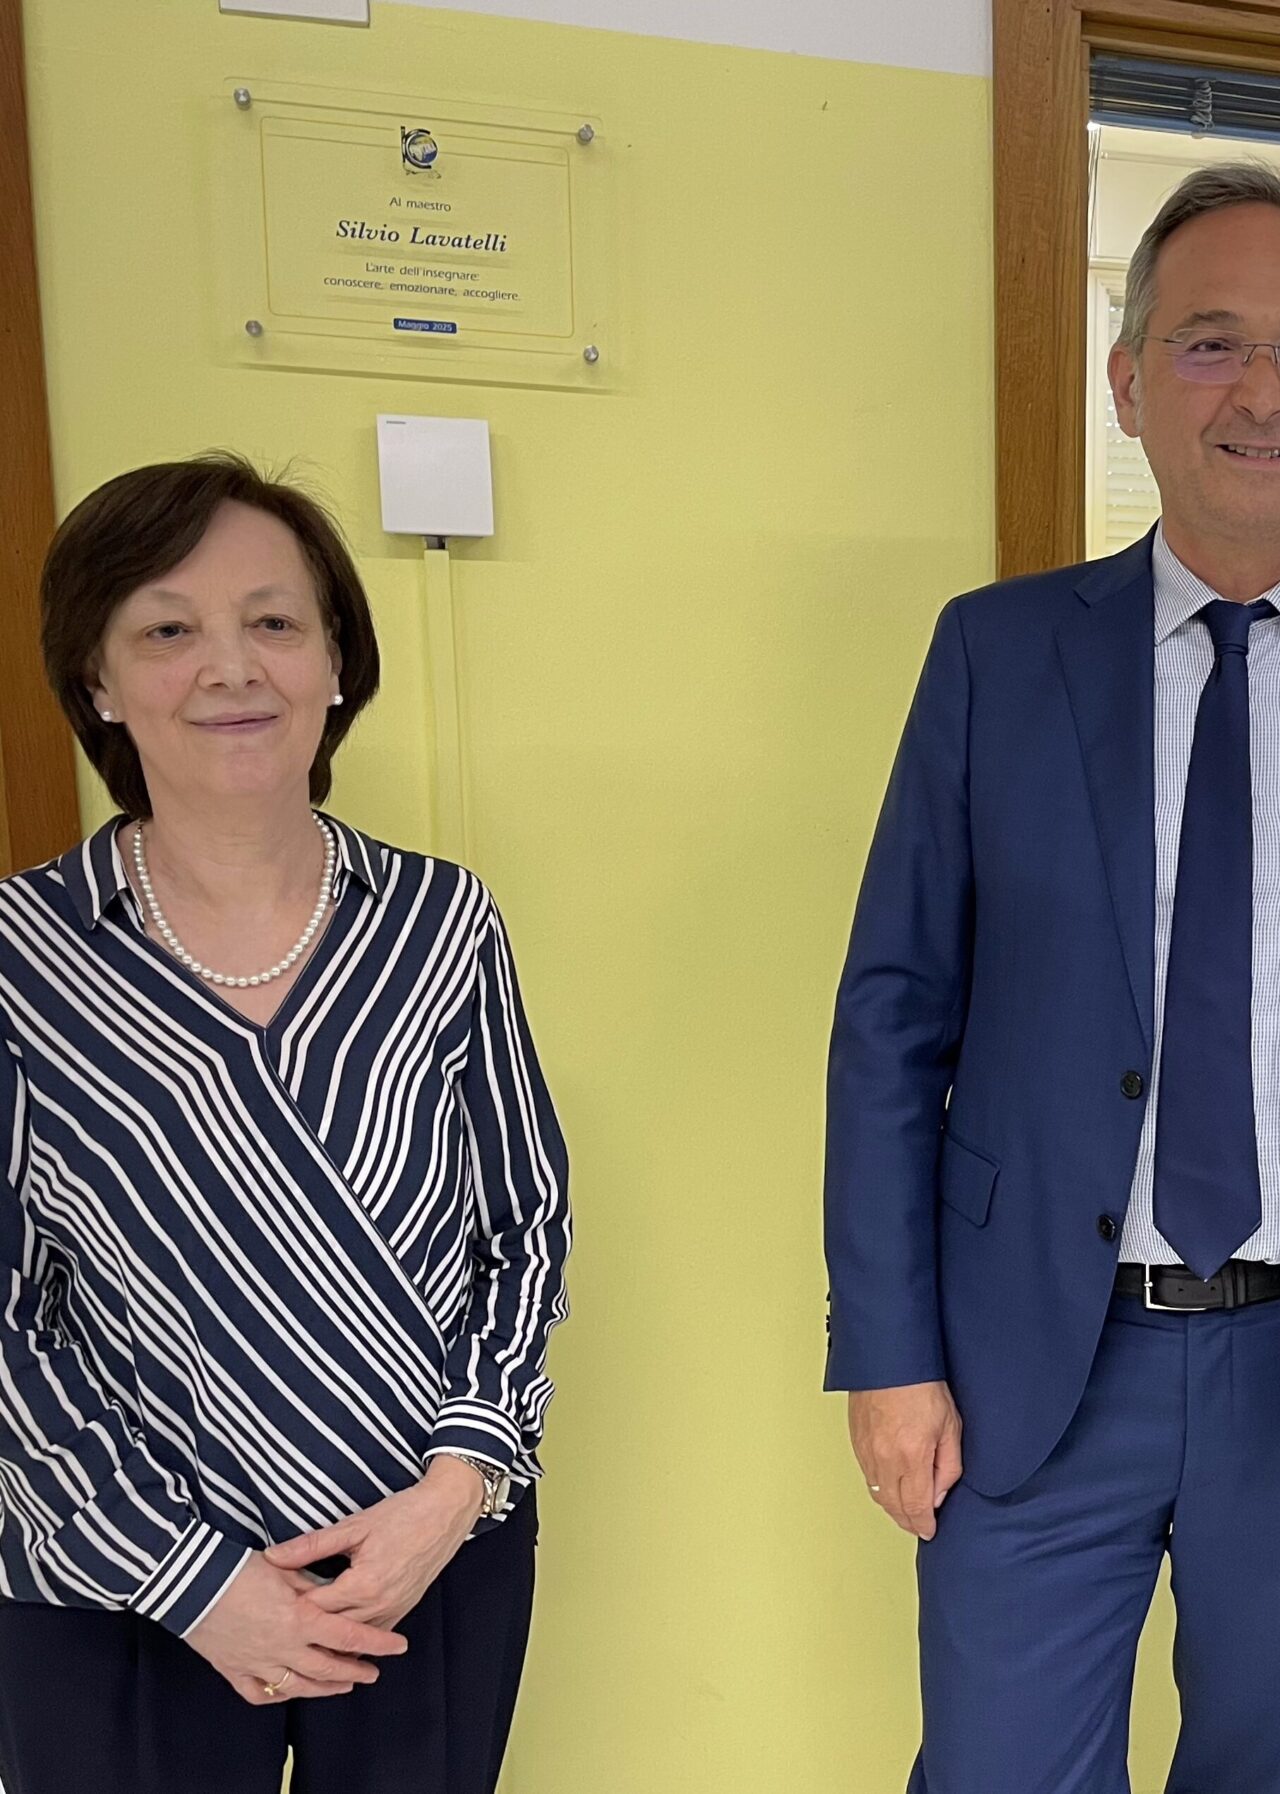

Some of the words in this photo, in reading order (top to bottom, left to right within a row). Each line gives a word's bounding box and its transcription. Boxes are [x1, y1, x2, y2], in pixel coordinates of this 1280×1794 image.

[389, 196, 402, 207] Al
[406, 199, 452, 212] maestro
[336, 220, 400, 243] Silvio
[409, 226, 507, 252] Lavatelli
[365, 262, 395, 274] L'arte
[323, 276, 384, 290] conoscere,
[389, 282, 458, 297] emozionare,
[463, 287, 521, 302] accogliere.
[398, 319, 430, 332] Maggio
[432, 322, 453, 333] 2025
